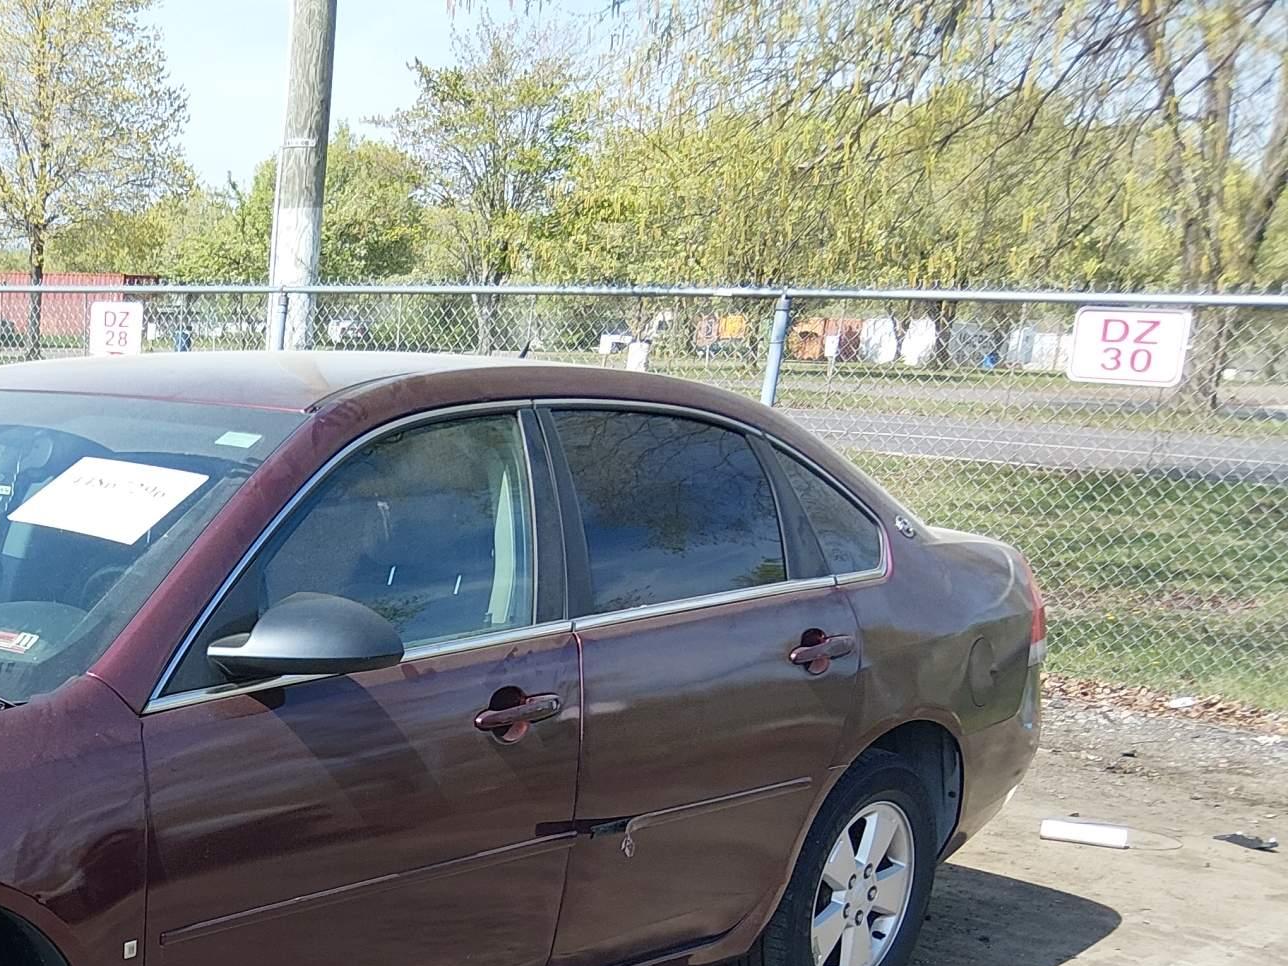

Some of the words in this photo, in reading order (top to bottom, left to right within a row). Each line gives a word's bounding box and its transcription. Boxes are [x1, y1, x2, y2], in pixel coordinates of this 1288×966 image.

[104, 310, 130, 328] DZ
[105, 329, 128, 347] 28
[1100, 318, 1162, 345] DZ
[1100, 346, 1153, 373] 30
